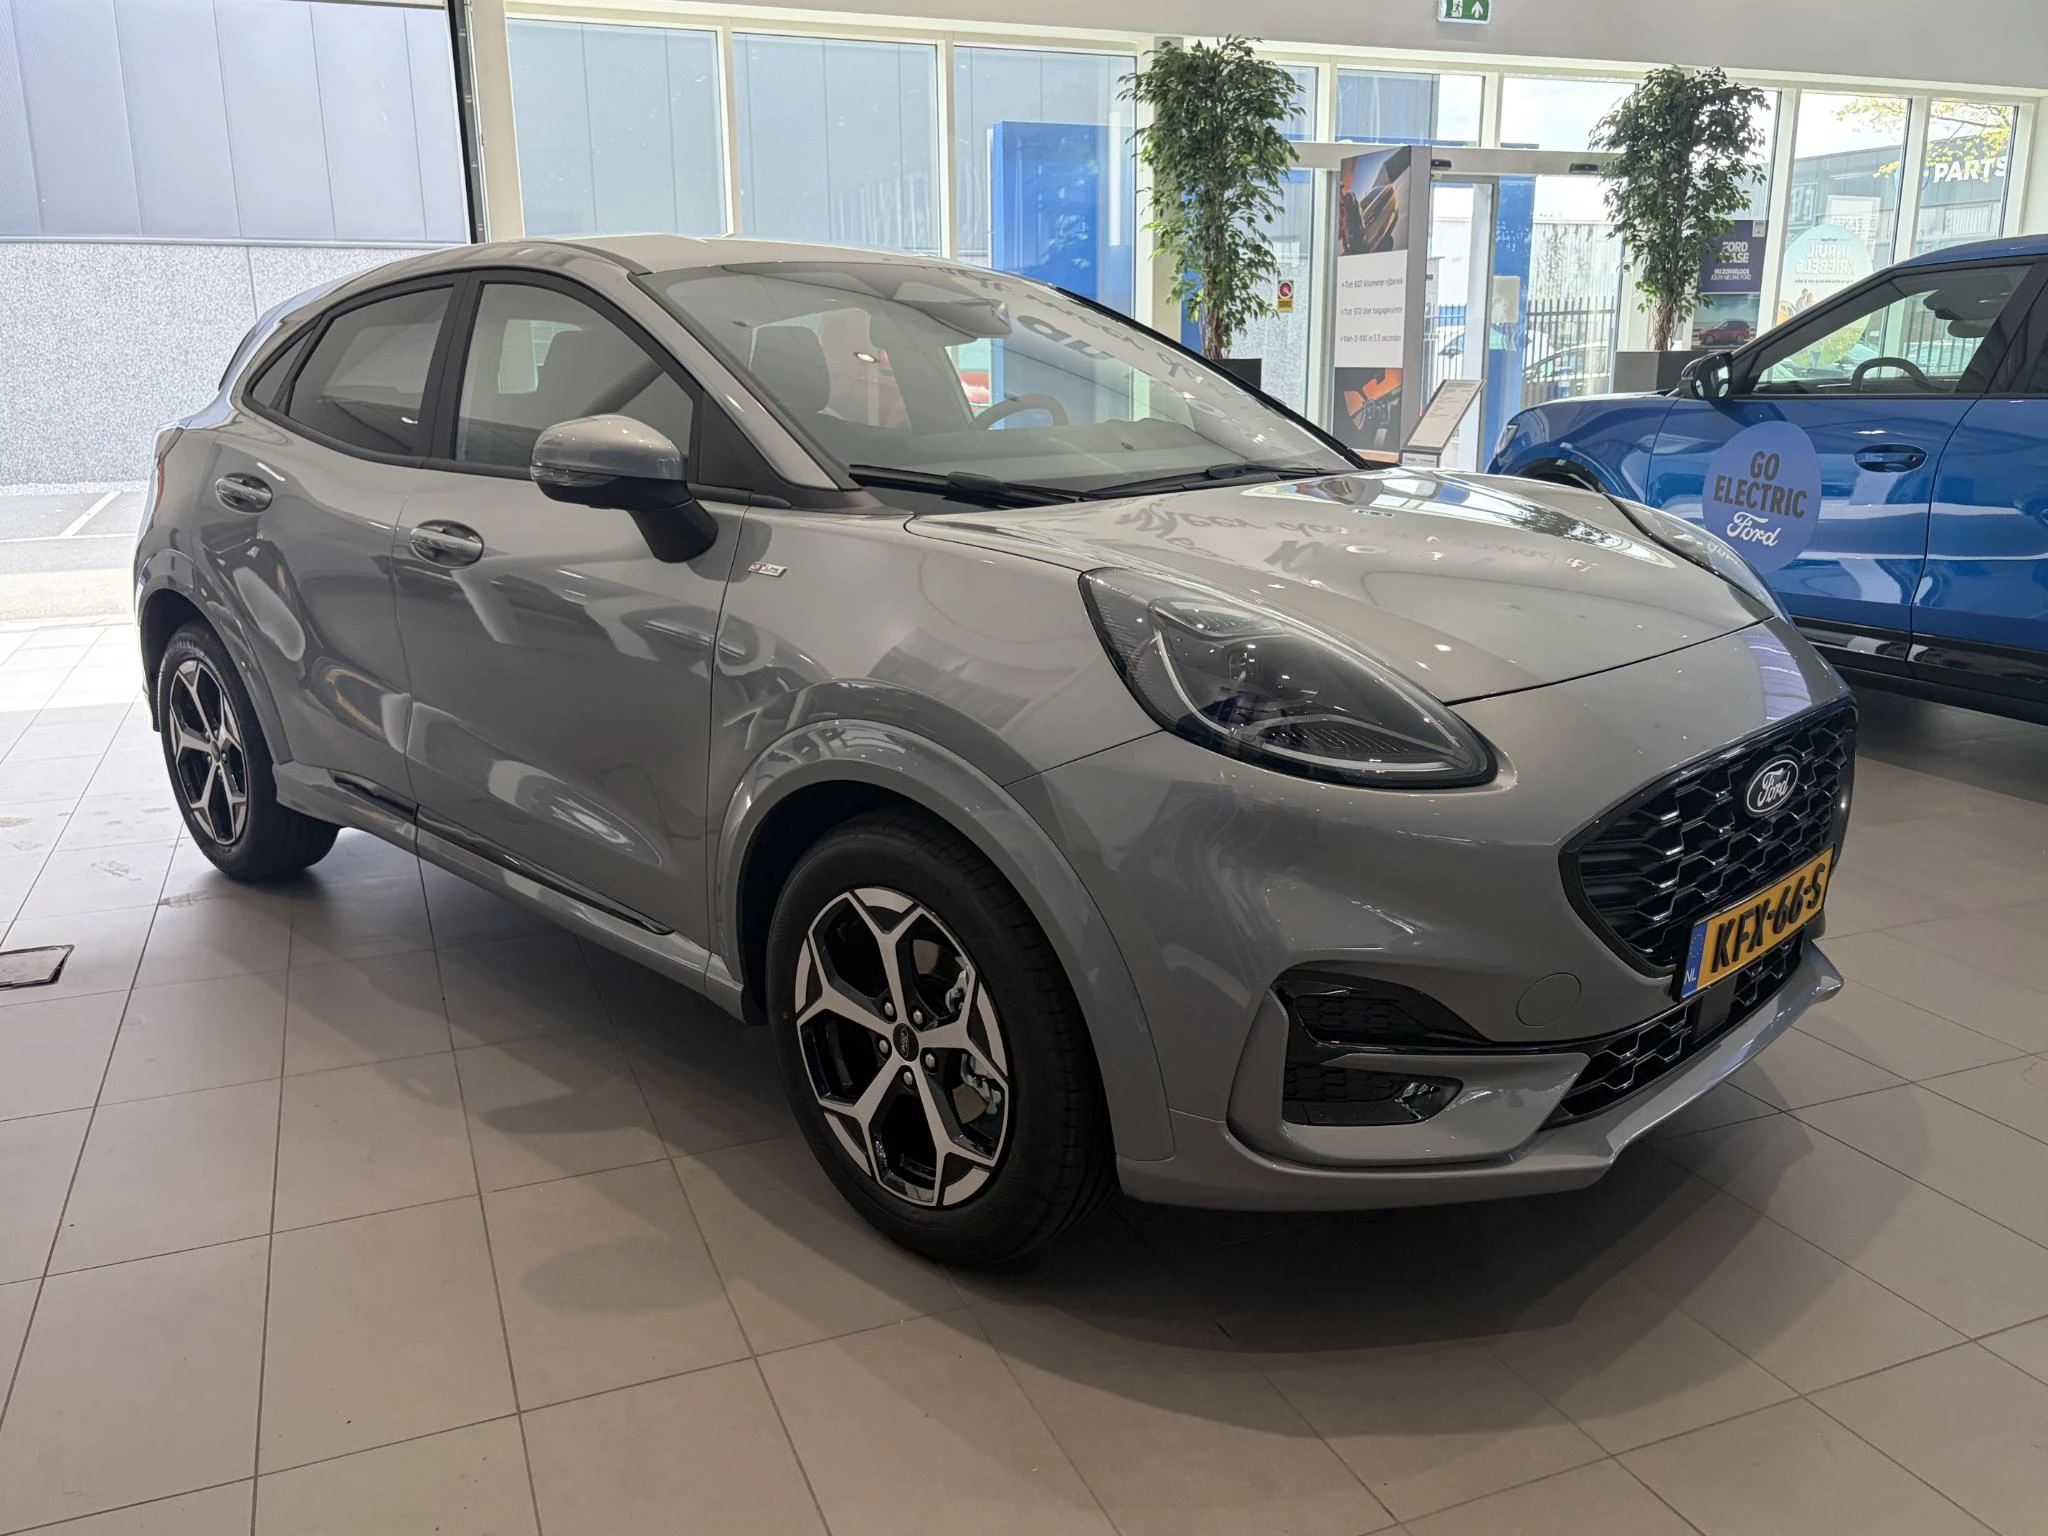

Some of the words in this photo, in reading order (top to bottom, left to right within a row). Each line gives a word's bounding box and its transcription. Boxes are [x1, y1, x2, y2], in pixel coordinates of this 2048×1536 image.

[1933, 156, 2007, 183] PARTS
[1720, 252, 1750, 263] ASE
[1750, 450, 1780, 481] GO
[1713, 474, 1808, 519] ELECTRIC
[1726, 511, 1782, 547] Ford
[1757, 767, 1791, 807] Ford
[1711, 862, 1827, 974] KFX-66-S
[1684, 969, 1698, 985] NL
